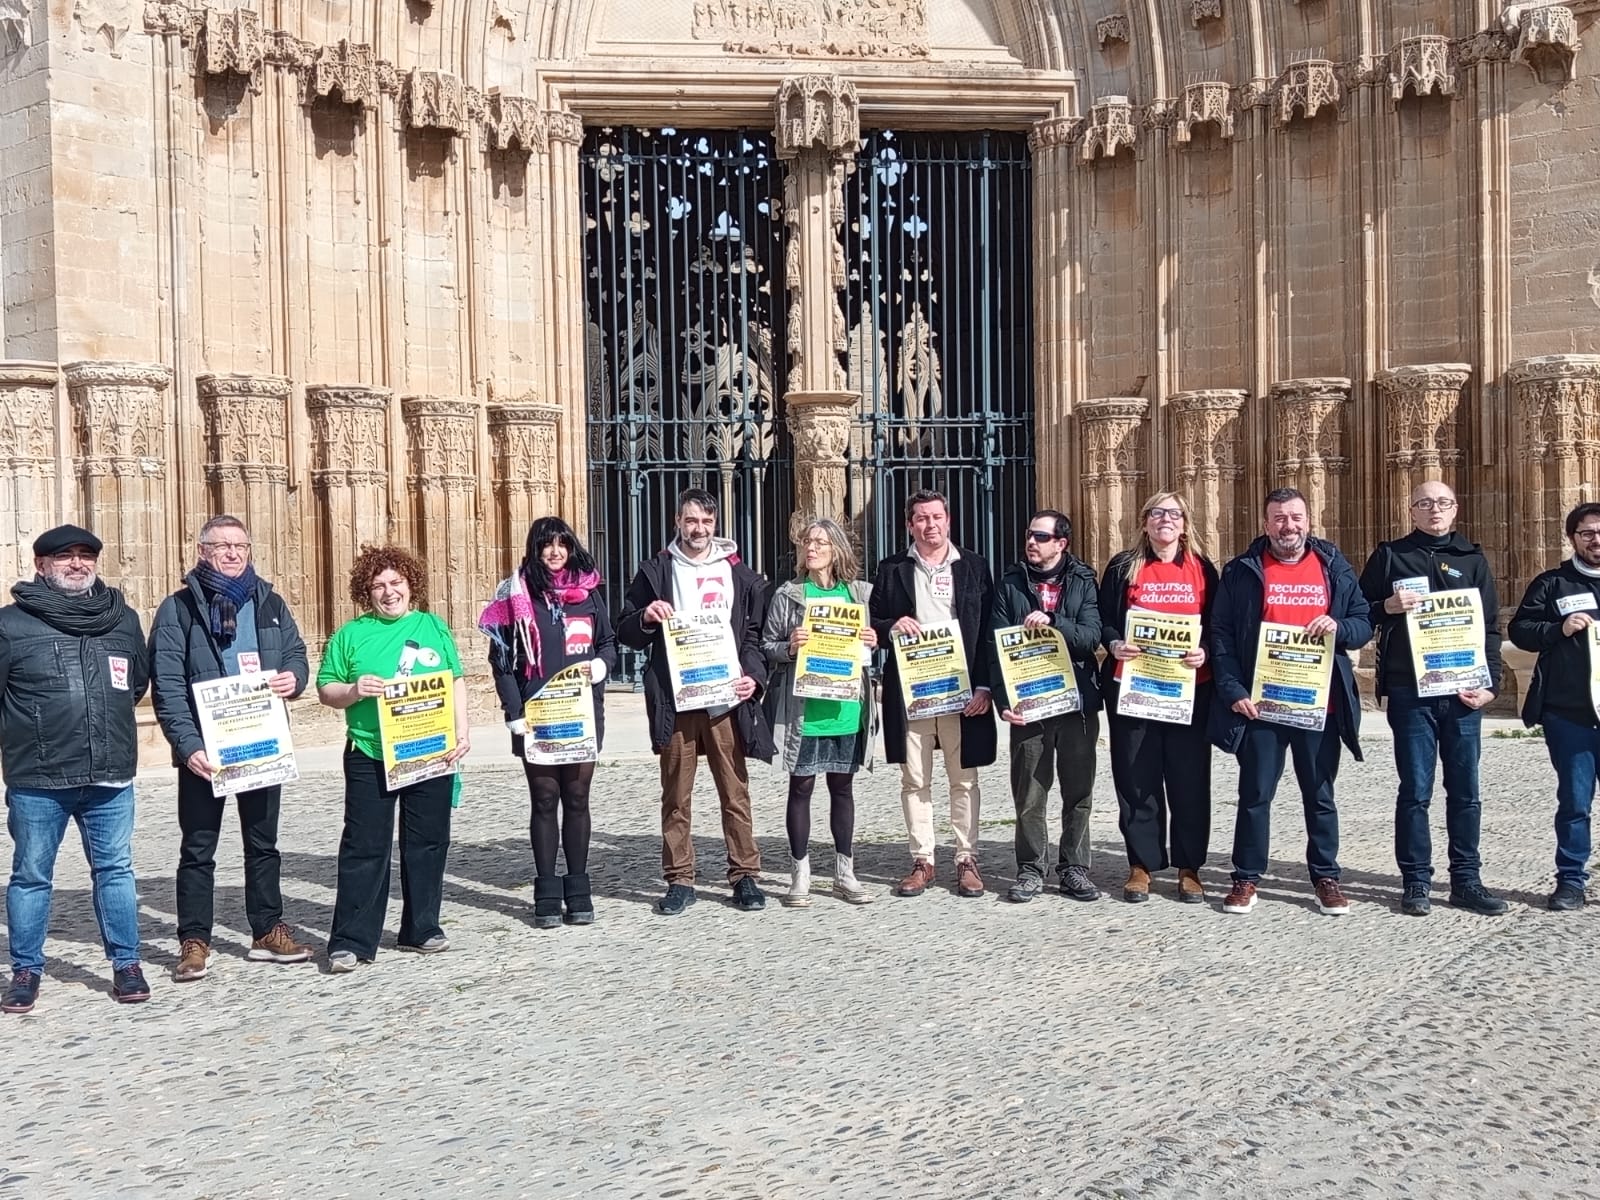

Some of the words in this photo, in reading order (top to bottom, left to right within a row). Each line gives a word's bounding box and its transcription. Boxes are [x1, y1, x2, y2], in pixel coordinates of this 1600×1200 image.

[1142, 582, 1193, 592] recursos
[1269, 583, 1324, 593] recursos
[1140, 592, 1195, 603] educació
[1267, 593, 1326, 606] educació
[1436, 596, 1472, 610] VAGA
[833, 607, 860, 620] VAGA
[921, 627, 952, 641] VAGA
[1024, 629, 1056, 640] VAGA
[1160, 628, 1191, 642] VAGA
[1292, 632, 1325, 647] VAGA
[567, 643, 591, 655] CGT
[552, 668, 580, 682] AGA
[410, 677, 445, 694] VAGA
